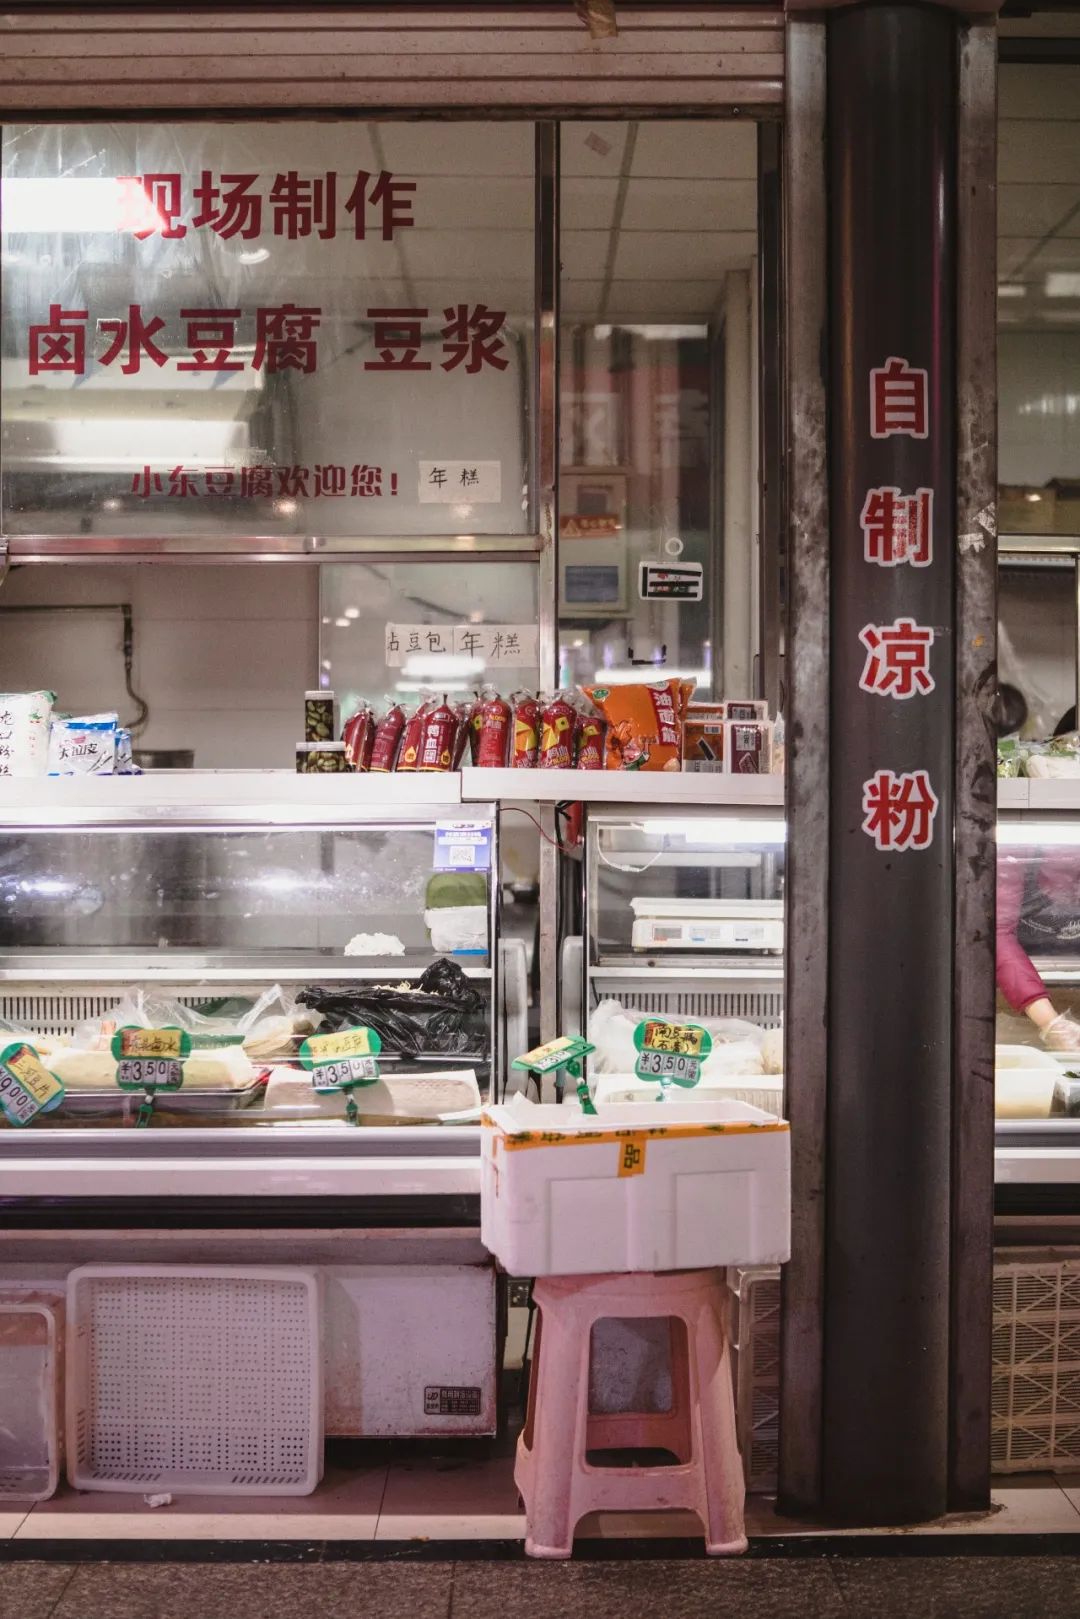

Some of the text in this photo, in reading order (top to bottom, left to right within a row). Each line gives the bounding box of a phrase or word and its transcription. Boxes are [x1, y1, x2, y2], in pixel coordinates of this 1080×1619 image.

[117, 170, 417, 241] 现场制作
[28, 304, 510, 375] 卤水豆腐 豆浆
[131, 465, 399, 497] 小东豆腐欢迎您!
[428, 466, 481, 488] 年糕
[860, 357, 939, 851] 自制凉粉
[460, 631, 521, 659] 年糕
